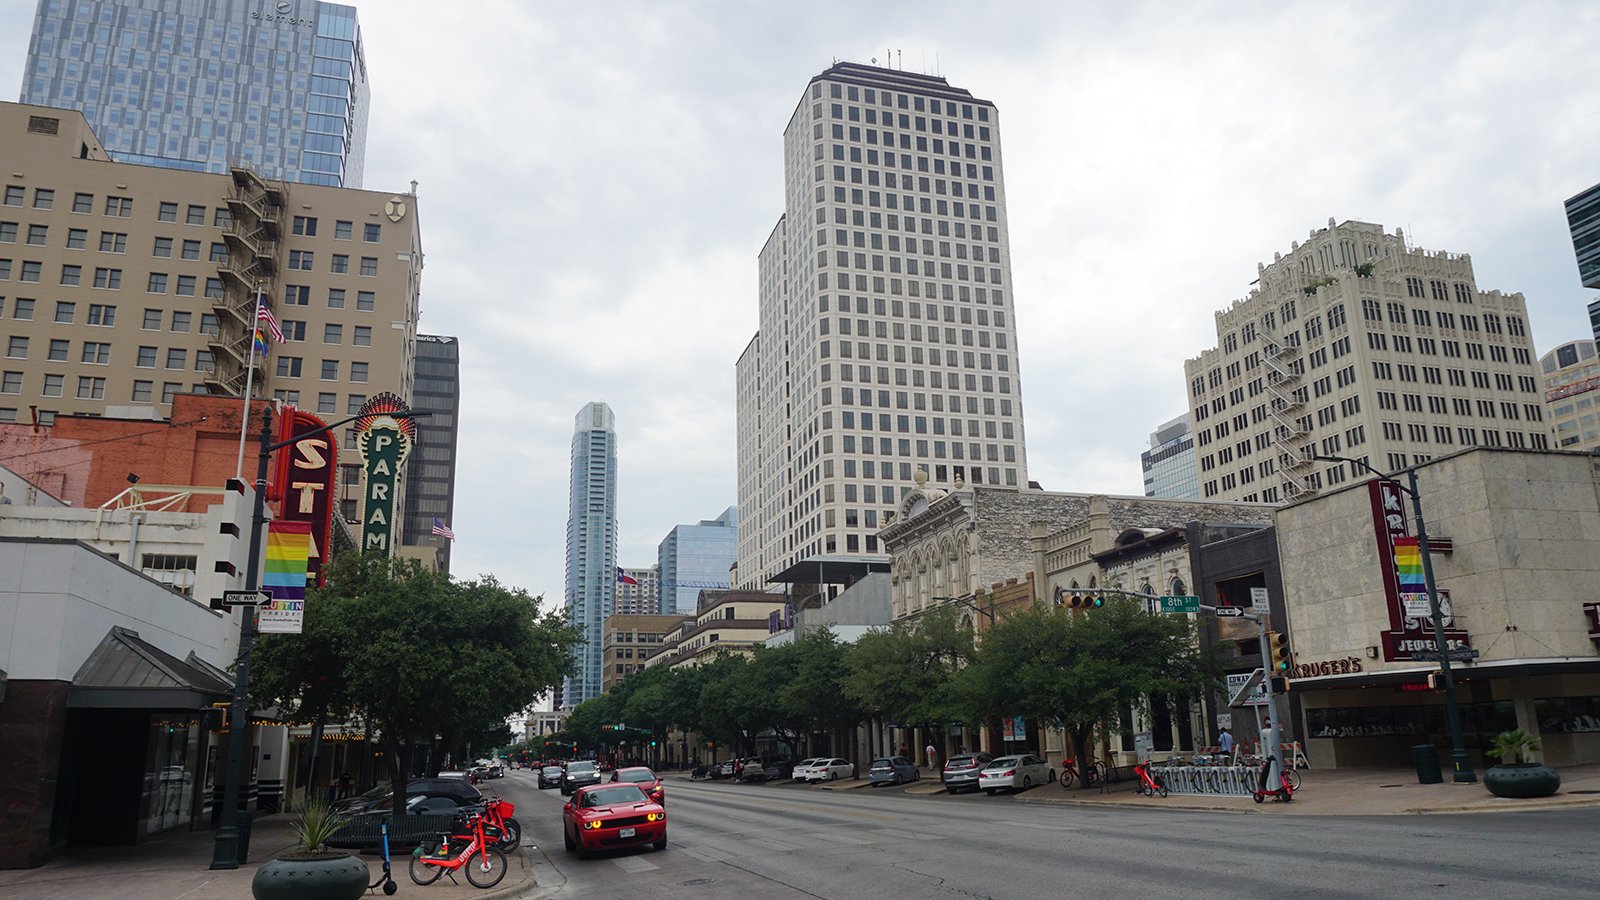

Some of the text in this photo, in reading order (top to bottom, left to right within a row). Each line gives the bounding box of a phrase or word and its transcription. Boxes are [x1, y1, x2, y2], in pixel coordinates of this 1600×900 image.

[250, 11, 313, 28] element
[366, 435, 392, 550] PARAM
[1167, 597, 1182, 606] 8th
[1398, 639, 1464, 651] JEWELRS
[1291, 656, 1363, 678] KRUGER'S
[459, 842, 477, 863] JUMP
